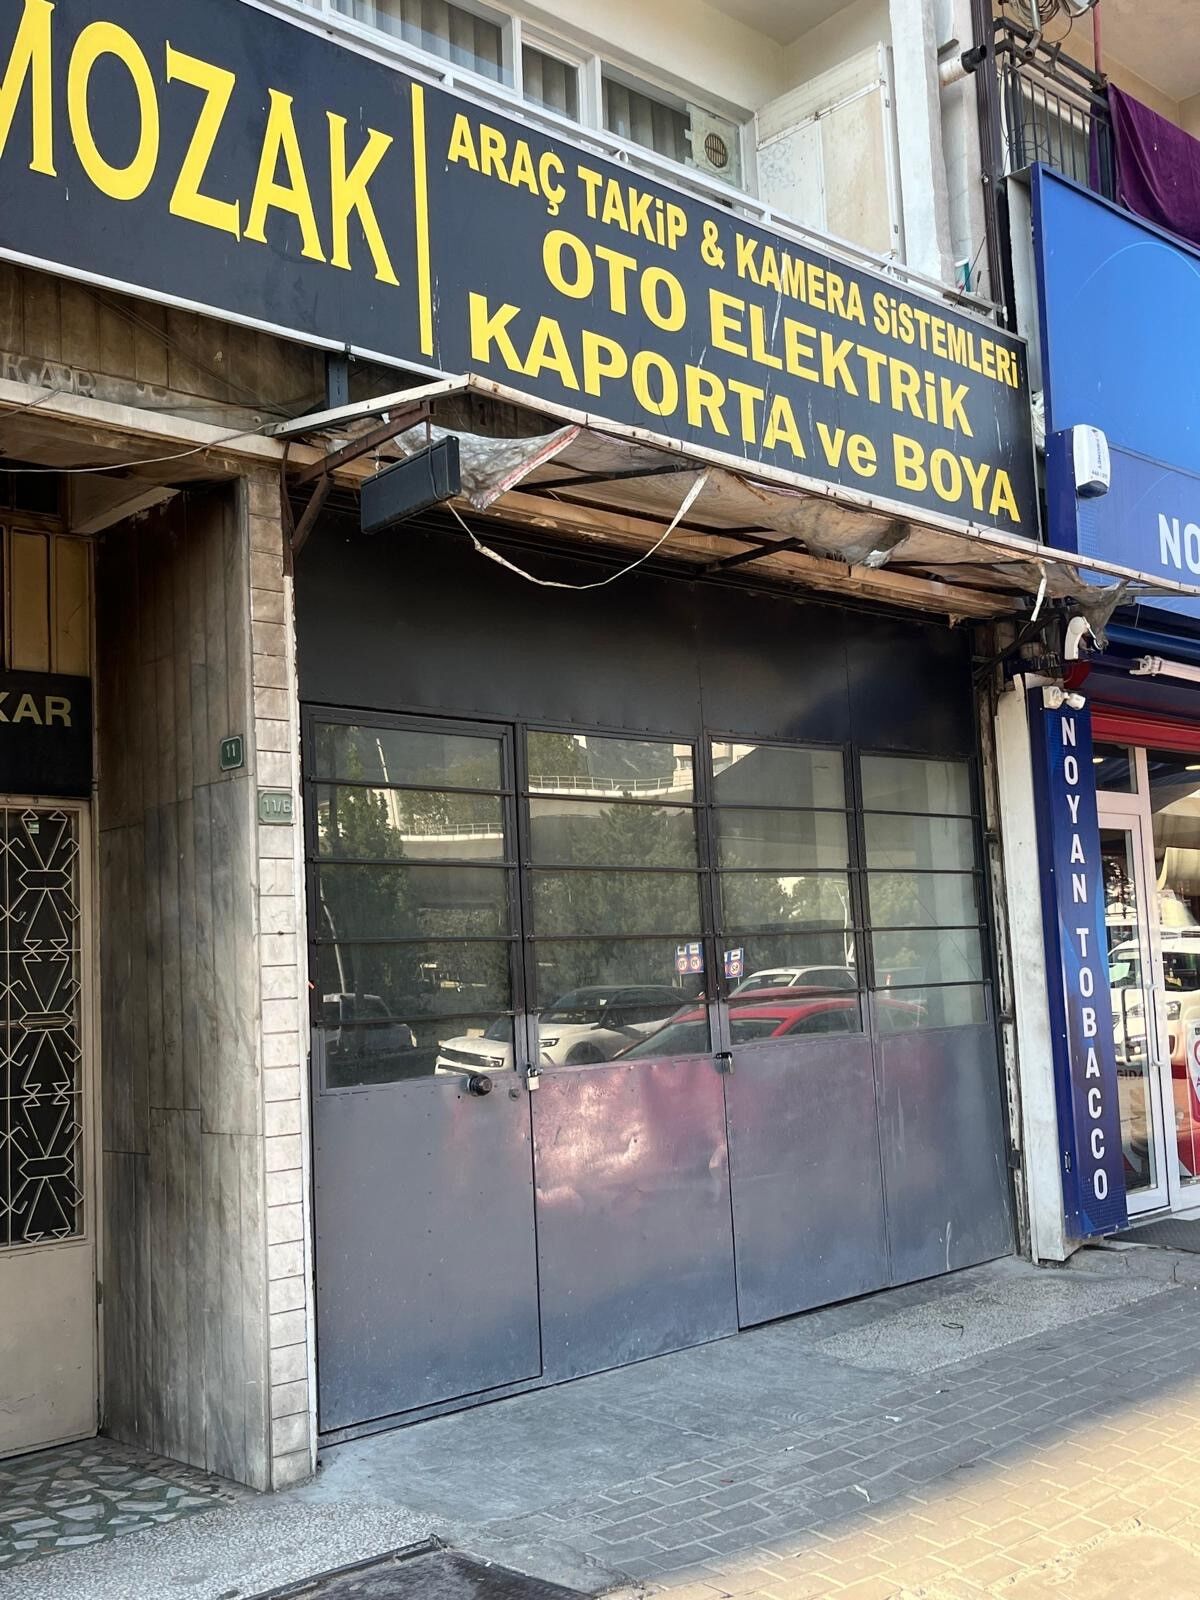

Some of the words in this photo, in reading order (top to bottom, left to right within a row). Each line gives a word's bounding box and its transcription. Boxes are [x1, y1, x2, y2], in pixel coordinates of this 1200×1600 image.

[448, 113, 566, 216] ARAÇ
[701, 219, 726, 269] &
[736, 233, 866, 325] KAMERA
[542, 230, 687, 333] OTO
[469, 291, 807, 459] KAPORTA
[817, 422, 878, 478] ve
[893, 434, 1021, 524] BOYA
[1158, 512, 1200, 575] NO
[226, 744, 236, 758] 11
[1061, 716, 1088, 904] NOYAN
[1075, 926, 1108, 1201] TOBACCO
